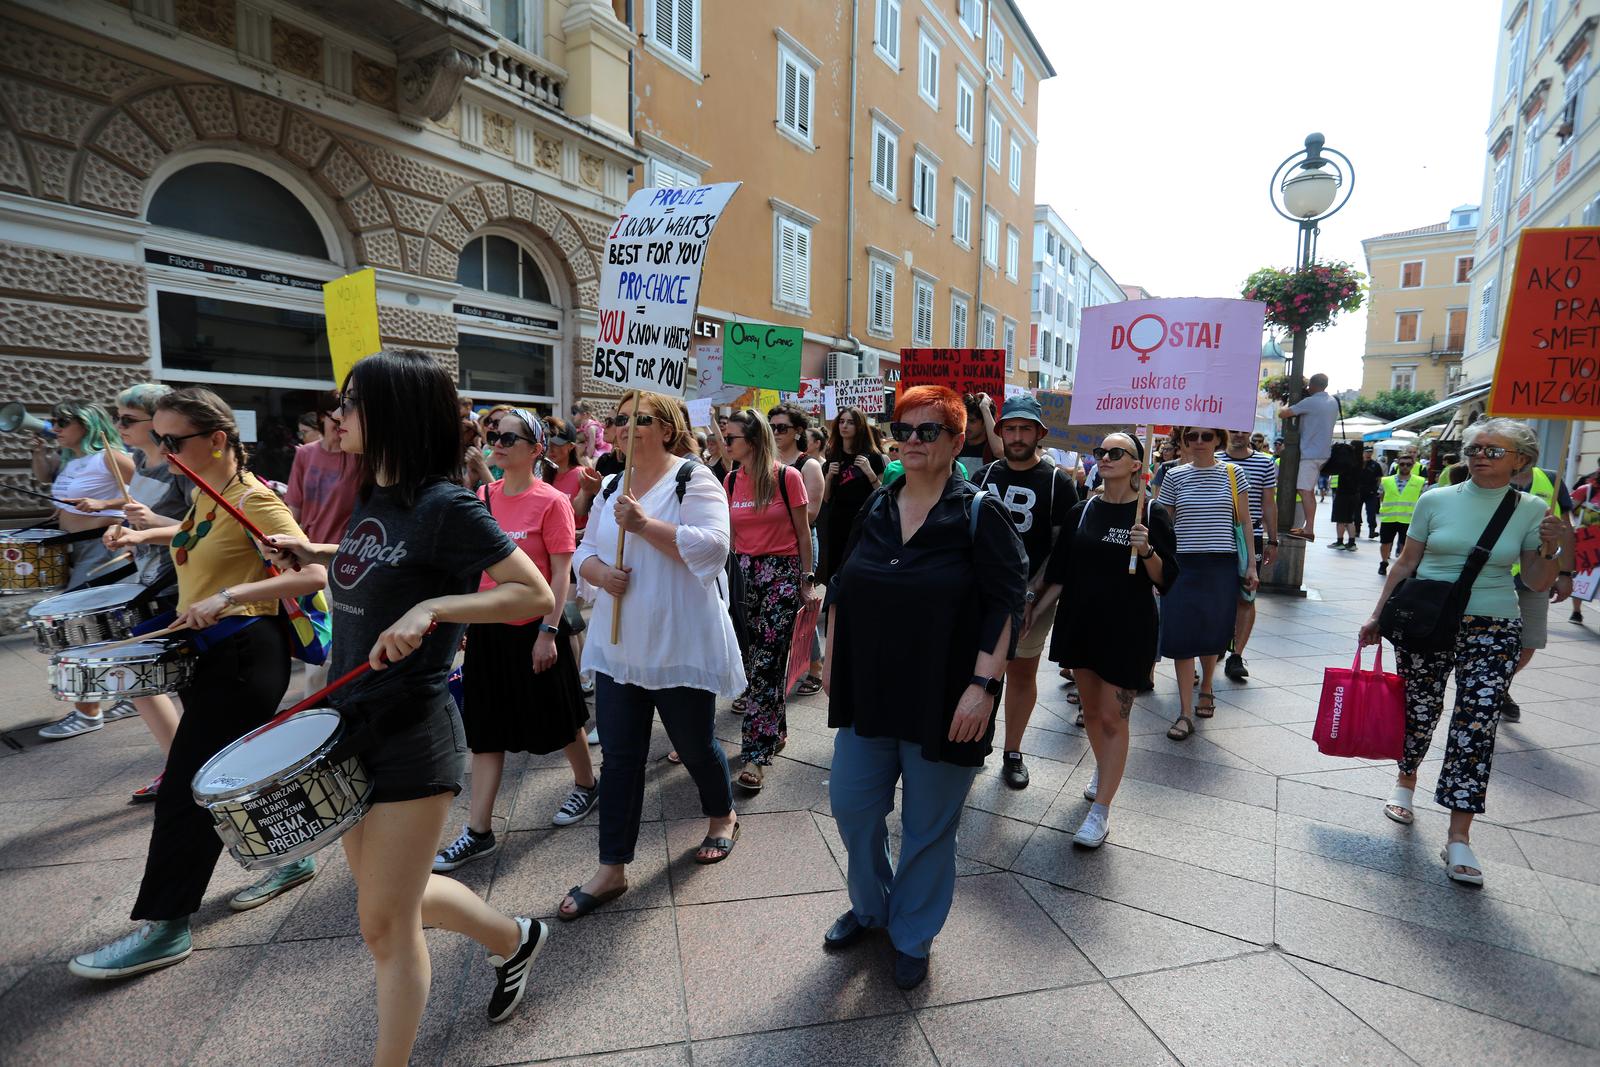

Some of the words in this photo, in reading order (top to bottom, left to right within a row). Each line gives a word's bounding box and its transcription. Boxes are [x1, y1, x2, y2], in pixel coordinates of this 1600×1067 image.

[610, 214, 628, 239] I
[622, 217, 663, 237] KNOW
[664, 214, 715, 238] WHAT'S
[609, 244, 642, 265] BEST
[647, 241, 673, 265] FOR
[281, 276, 288, 284] &
[618, 271, 690, 304] PRO-CHOICE
[1527, 266, 1581, 291] AKO
[598, 309, 625, 345] YOU
[627, 320, 661, 345] KNOW
[663, 326, 690, 351] WHAT'S
[1111, 314, 1222, 364] DOSTA!
[1531, 326, 1600, 350] SMET
[594, 347, 634, 383] BEST
[635, 358, 656, 380] FOR
[1131, 372, 1187, 390] uskrate
[1096, 393, 1180, 411] zdravstvene
[1184, 394, 1223, 414] skrbi
[358, 535, 408, 567] Rock
[340, 564, 358, 576] CAFE
[1330, 686, 1344, 739] emmezeta
[243, 798, 268, 811] CRKVA
[267, 795, 272, 803] I
[272, 782, 301, 800] DRŽAVA
[270, 798, 289, 813] RATU
[258, 813, 283, 827] PROTIV
[283, 801, 306, 817] ŽENA!
[268, 813, 308, 838] NEMA
[267, 819, 324, 853] PREDAJE!
